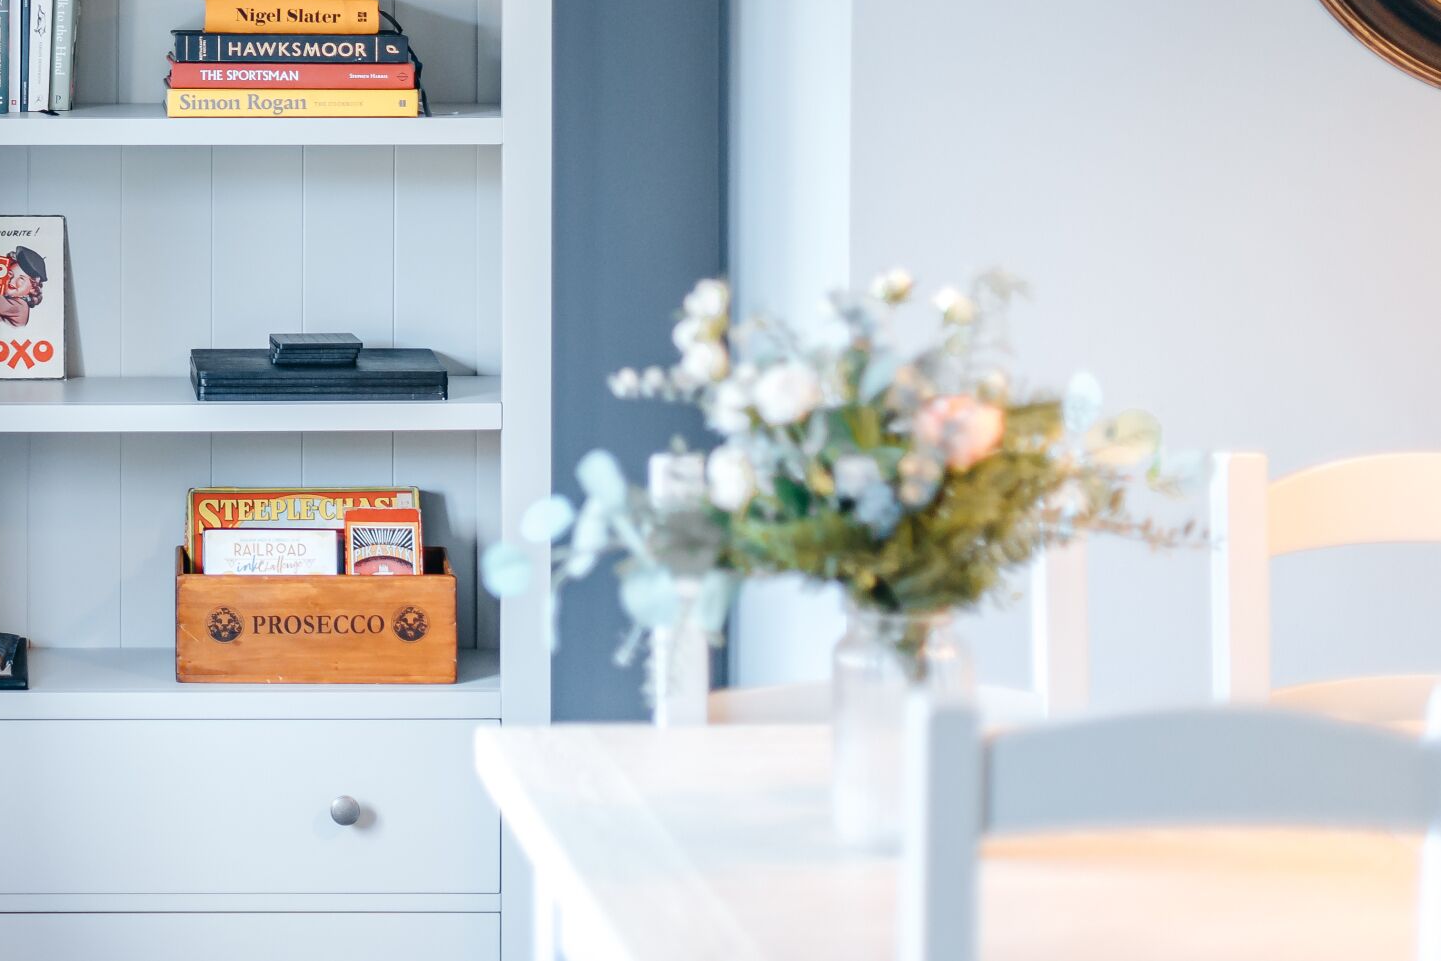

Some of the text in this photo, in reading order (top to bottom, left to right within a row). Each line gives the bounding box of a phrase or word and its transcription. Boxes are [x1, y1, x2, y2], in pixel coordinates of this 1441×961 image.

[57, 11, 67, 22] to
[235, 8, 282, 26] Nigel
[286, 8, 342, 24] Slater
[56, 24, 68, 42] the
[228, 42, 367, 57] HAWKSMOOR
[55, 46, 67, 76] Hand
[200, 70, 299, 81] THE SPORTSMAN
[180, 94, 307, 114] Simon Rogan
[198, 497, 398, 534] STEEPLE-CH
[234, 542, 307, 556] RAILROAD
[236, 555, 257, 572] ink
[252, 614, 385, 635] PROSECCO
